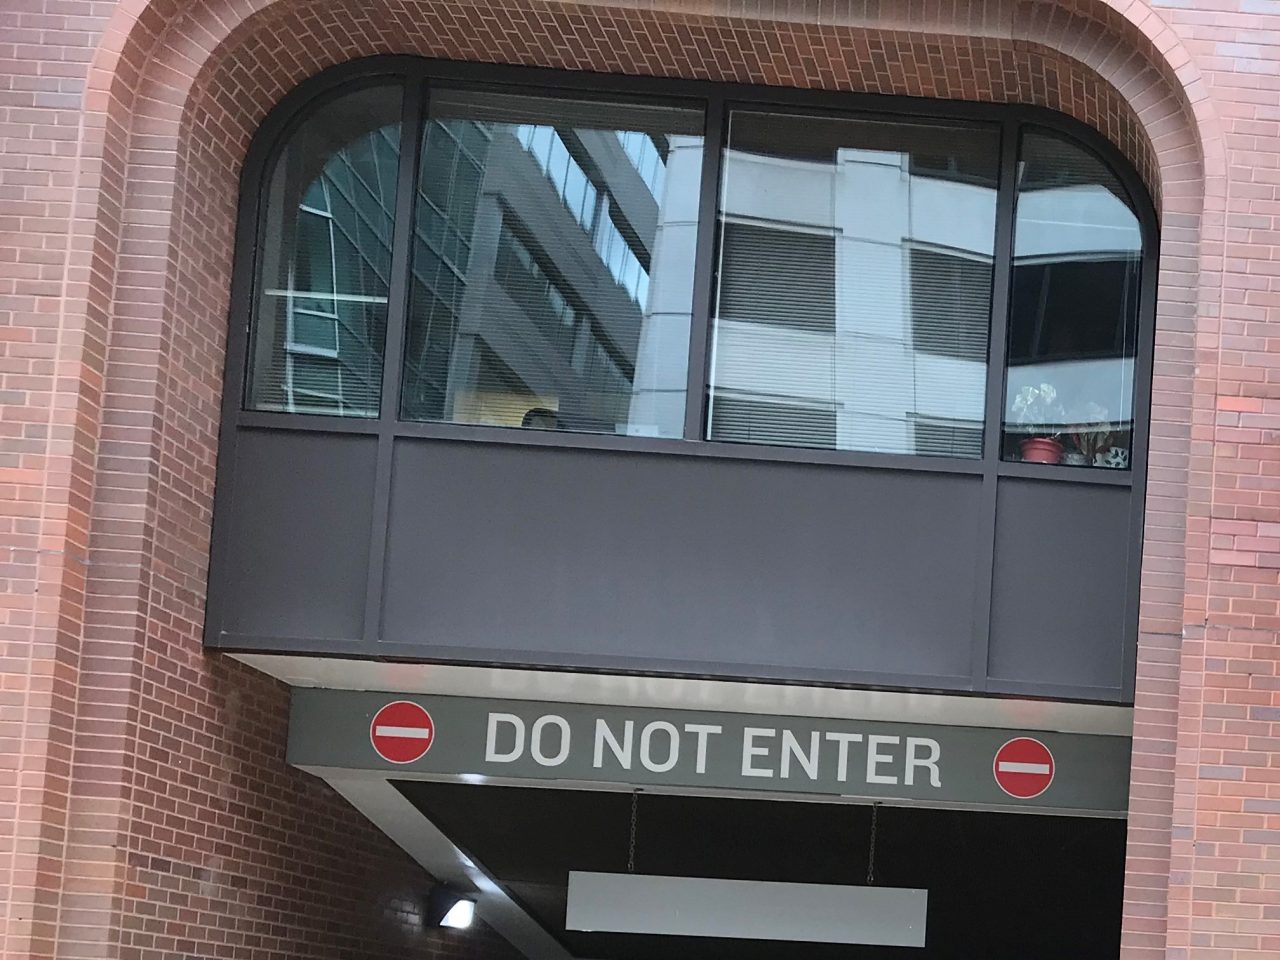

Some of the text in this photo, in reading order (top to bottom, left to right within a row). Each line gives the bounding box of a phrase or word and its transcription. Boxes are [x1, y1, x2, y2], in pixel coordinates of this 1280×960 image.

[485, 712, 942, 787] DO NOT ENTER
